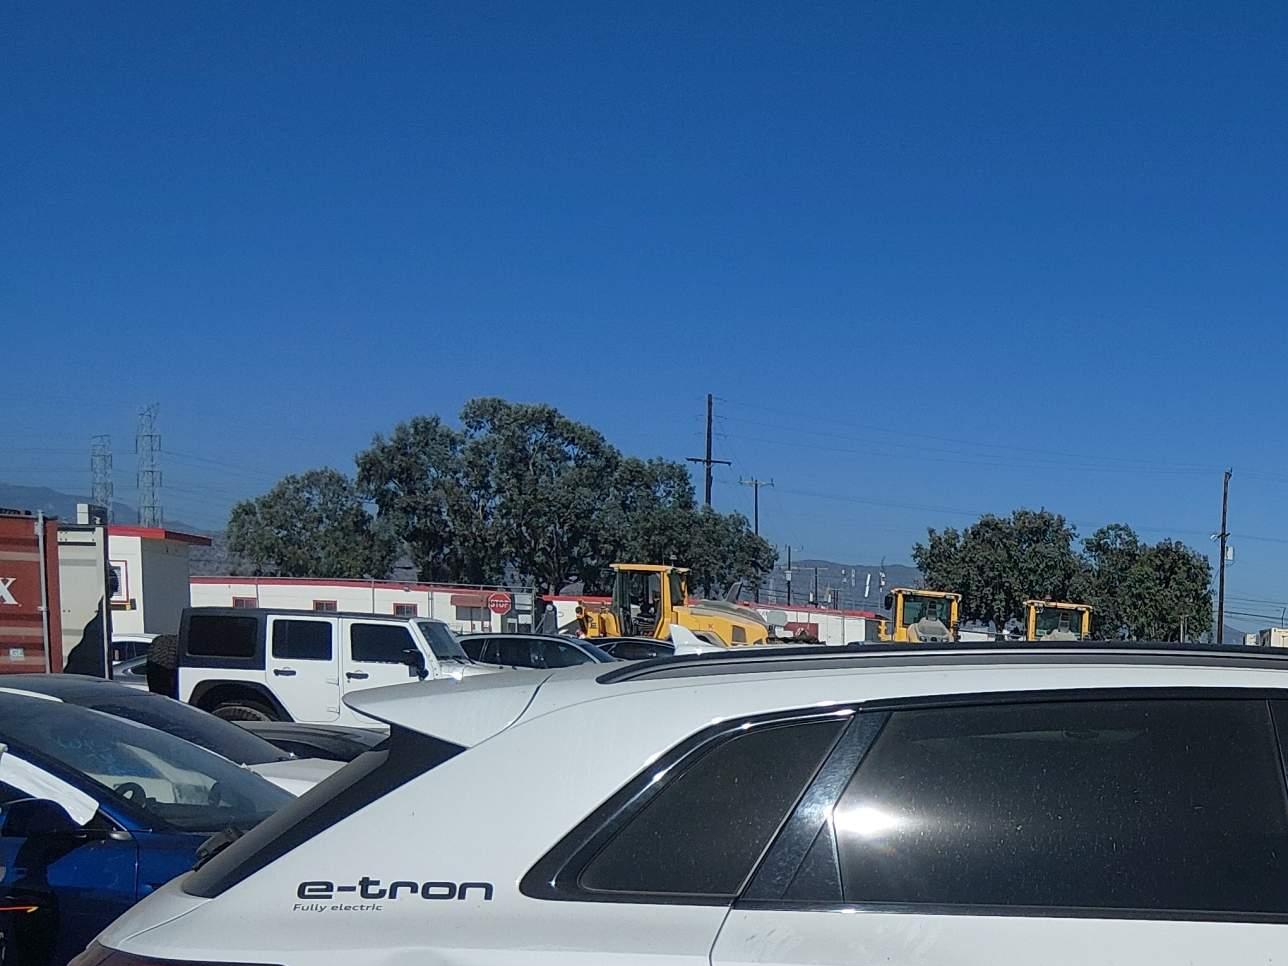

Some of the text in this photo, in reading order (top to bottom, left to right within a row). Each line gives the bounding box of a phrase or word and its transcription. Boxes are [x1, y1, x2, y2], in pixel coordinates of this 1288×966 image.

[490, 599, 510, 608] STOP
[297, 877, 494, 900] e-tron
[293, 904, 327, 913] Fully
